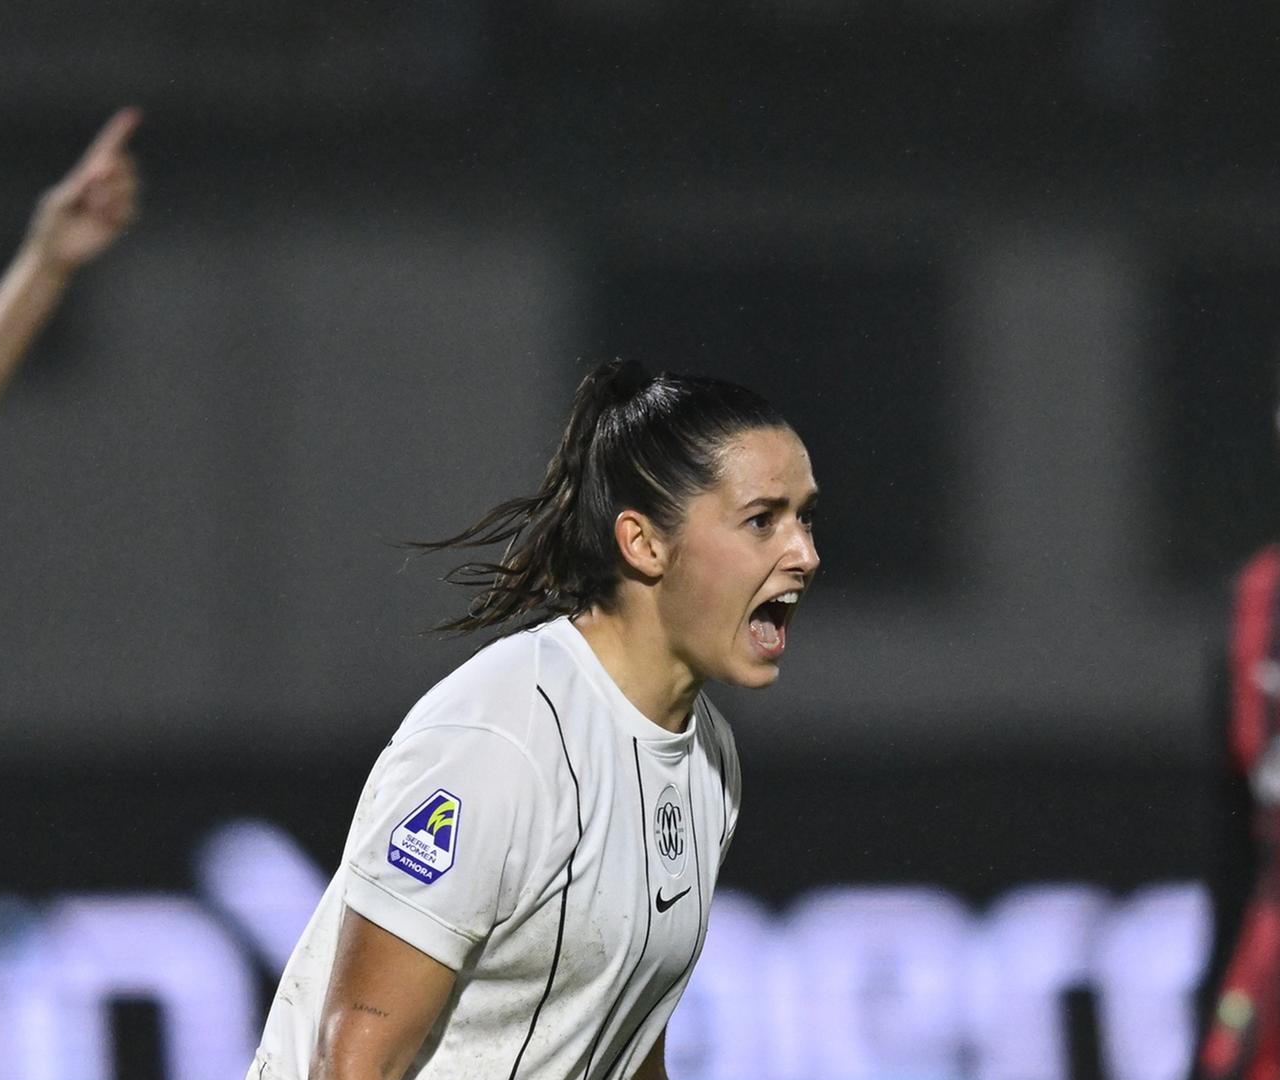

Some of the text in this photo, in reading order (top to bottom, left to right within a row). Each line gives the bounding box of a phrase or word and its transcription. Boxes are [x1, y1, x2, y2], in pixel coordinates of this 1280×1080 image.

[401, 840, 437, 864] WOMEN
[405, 834, 437, 858] SERIE A
[399, 857, 433, 880] ATHORA
